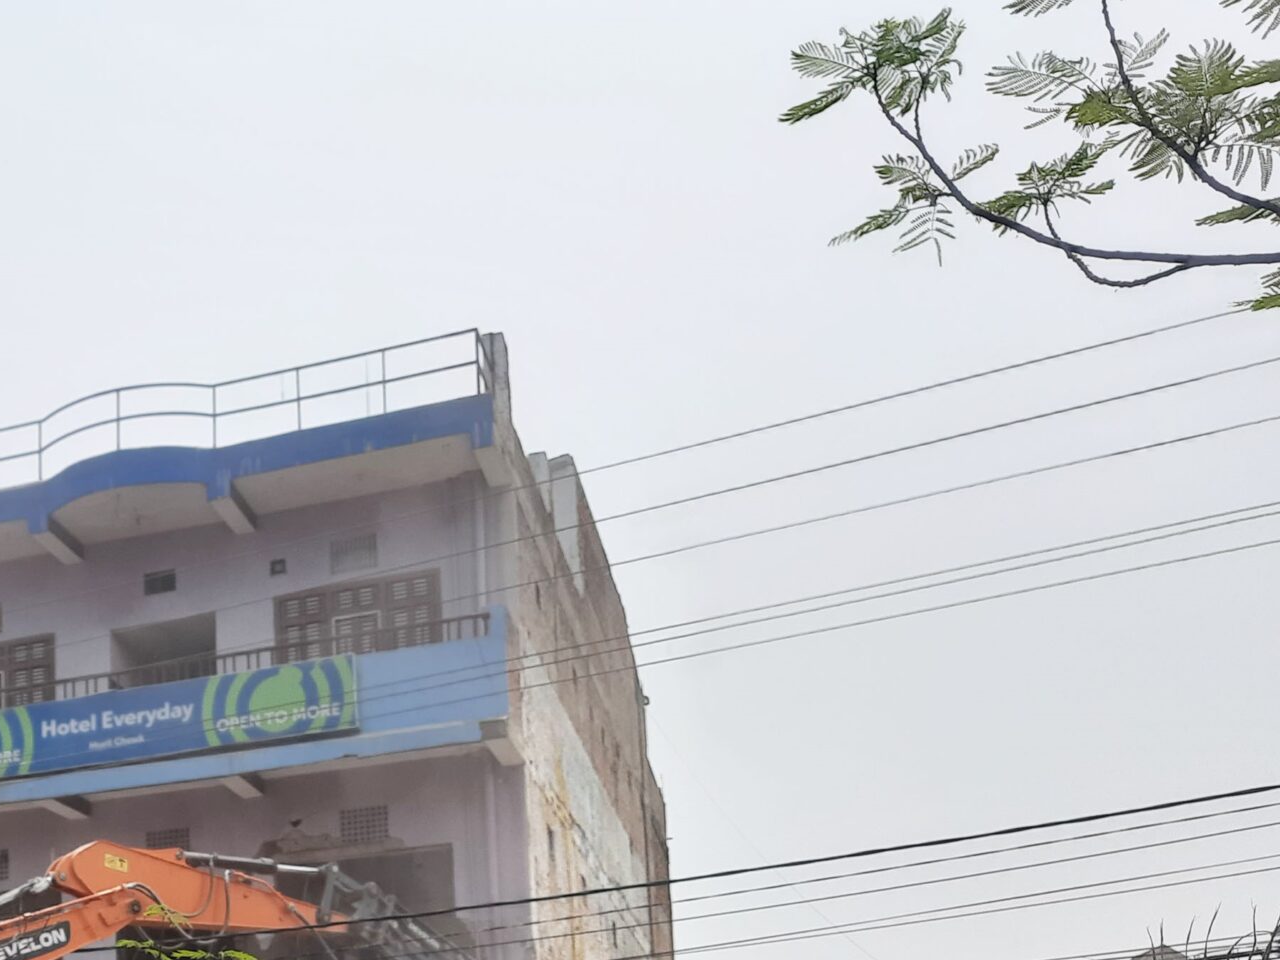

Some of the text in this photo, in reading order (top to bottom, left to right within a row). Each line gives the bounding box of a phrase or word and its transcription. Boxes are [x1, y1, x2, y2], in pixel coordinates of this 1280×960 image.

[41, 702, 194, 738] Hotel Everyday
[216, 702, 340, 732] OPEN TO MORE
